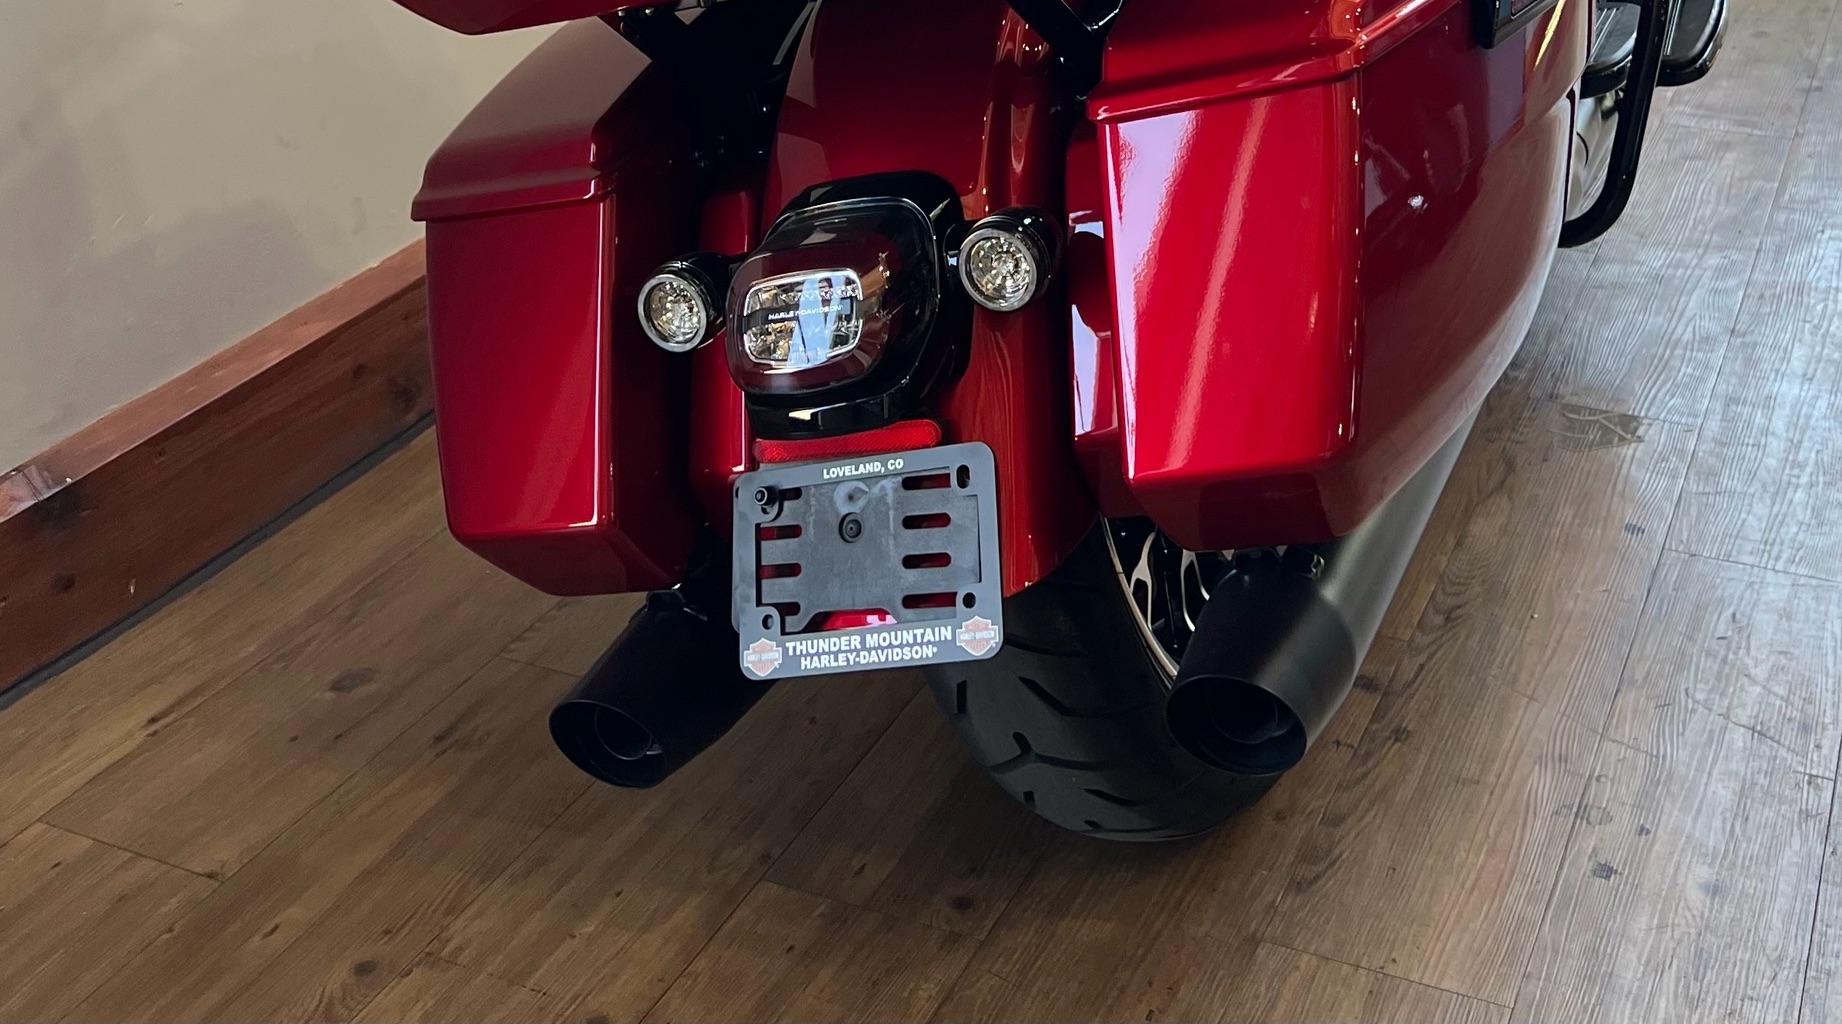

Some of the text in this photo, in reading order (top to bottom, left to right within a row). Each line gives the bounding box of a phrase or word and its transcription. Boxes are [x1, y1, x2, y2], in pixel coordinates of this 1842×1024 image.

[822, 458, 904, 479] LOVELAND, CO
[785, 635, 862, 657] THUNDER
[865, 625, 952, 649] MOUNTAIN
